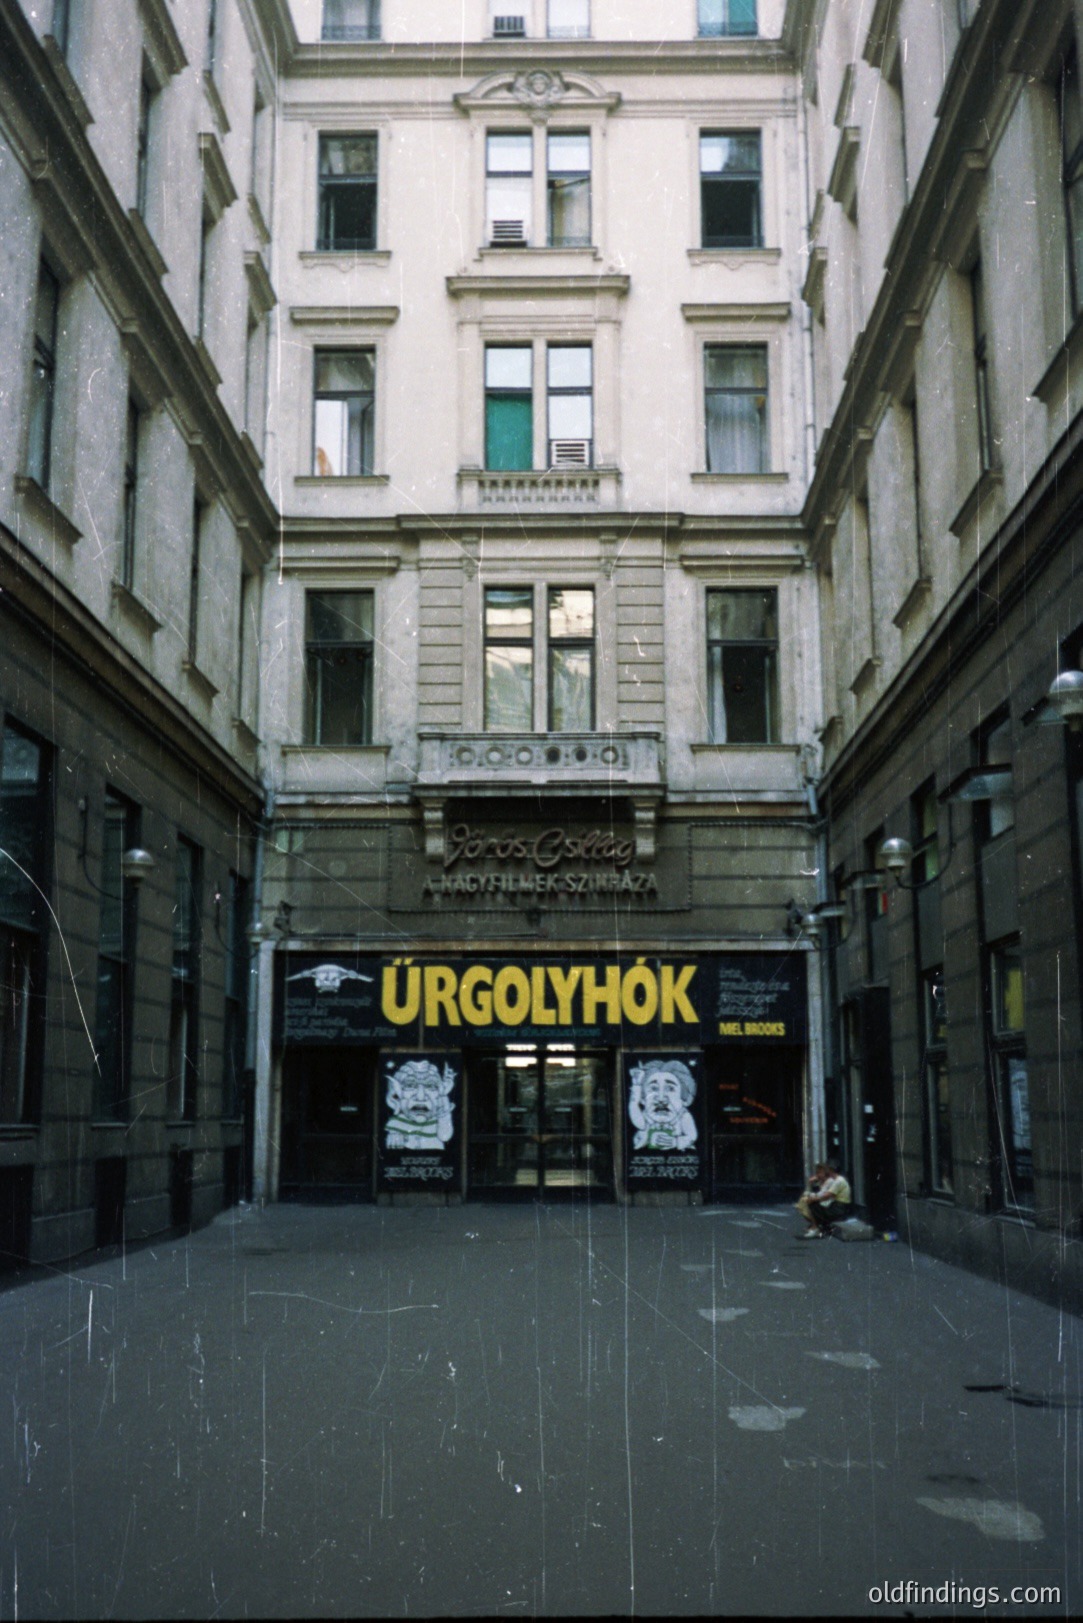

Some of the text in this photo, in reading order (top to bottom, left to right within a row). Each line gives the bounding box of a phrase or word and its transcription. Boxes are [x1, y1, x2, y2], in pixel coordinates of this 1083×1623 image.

[533, 826, 635, 869] Csillag
[441, 872, 558, 893] NAGYFILMEK
[719, 1022, 786, 1036] MEL BROOKS
